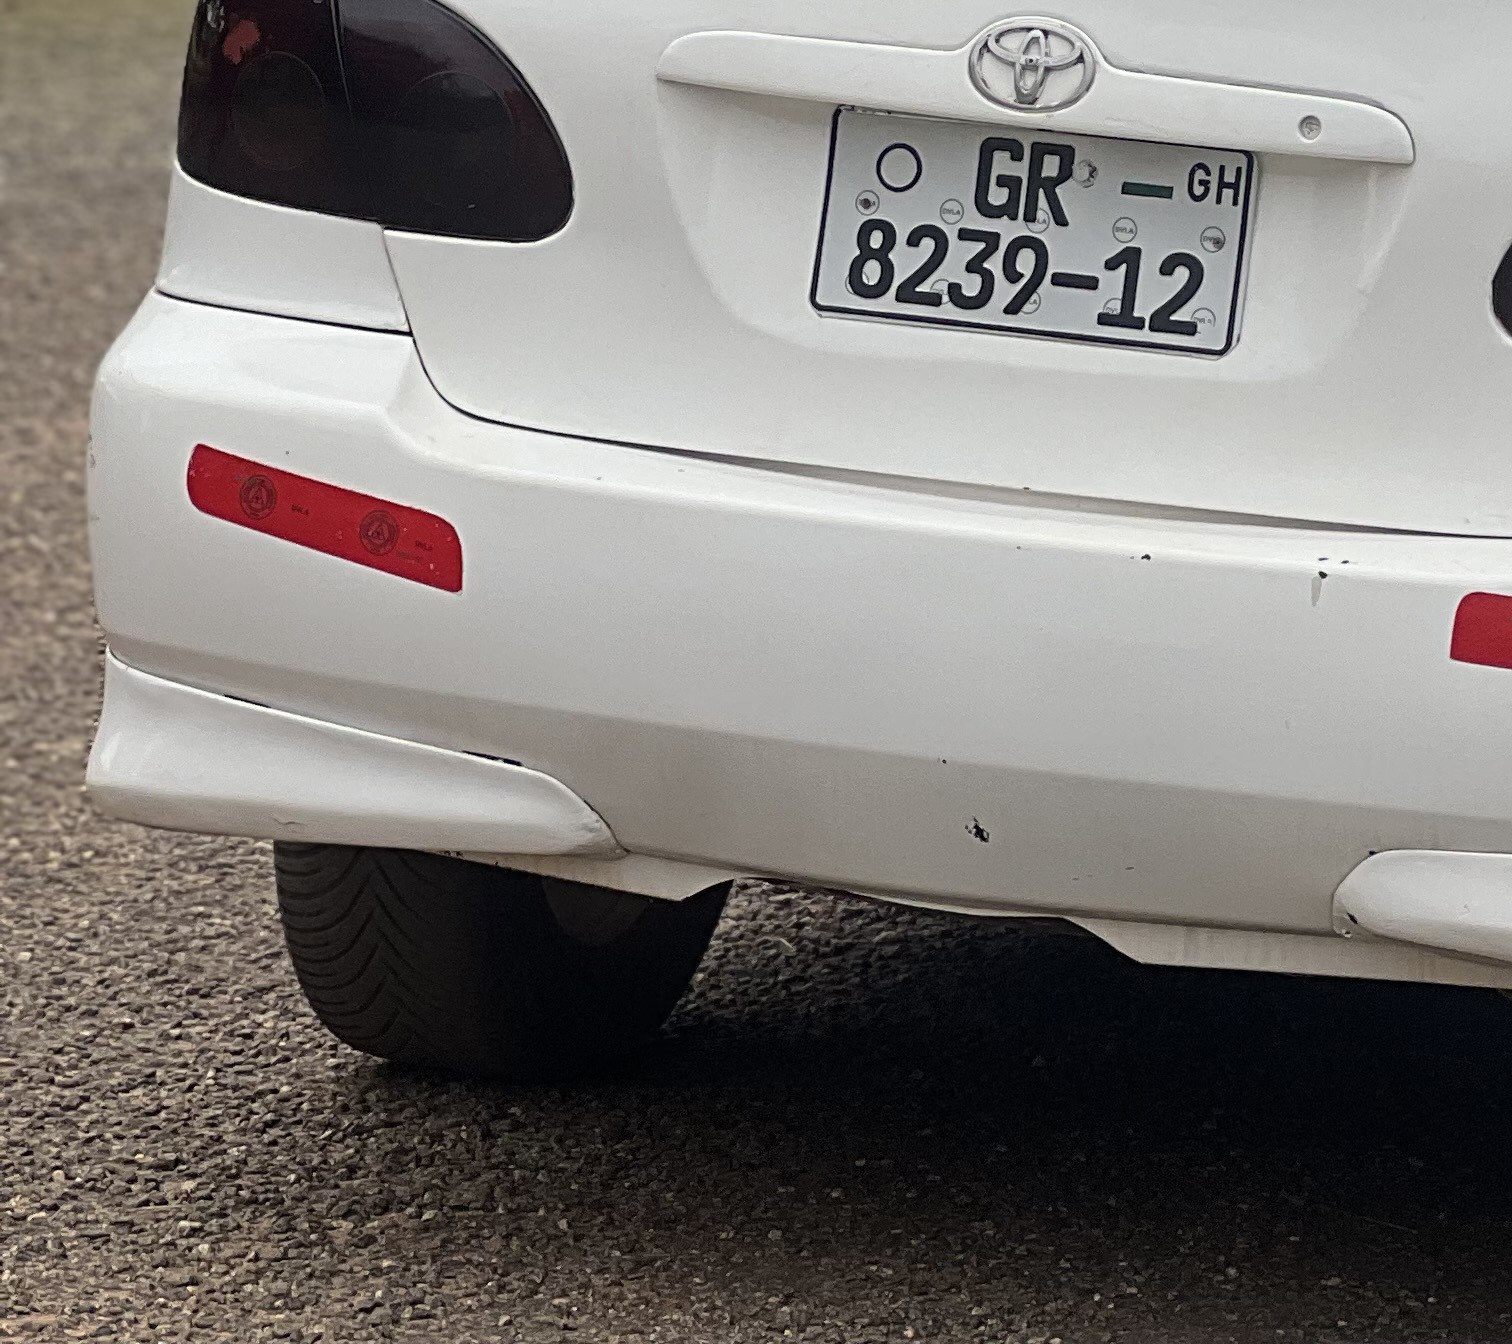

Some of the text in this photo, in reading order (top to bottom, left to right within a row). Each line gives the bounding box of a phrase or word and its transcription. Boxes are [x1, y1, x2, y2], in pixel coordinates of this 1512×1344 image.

[974, 136, 1076, 228] GR
[1186, 162, 1243, 207] GH
[847, 218, 1205, 337] 8239-12
